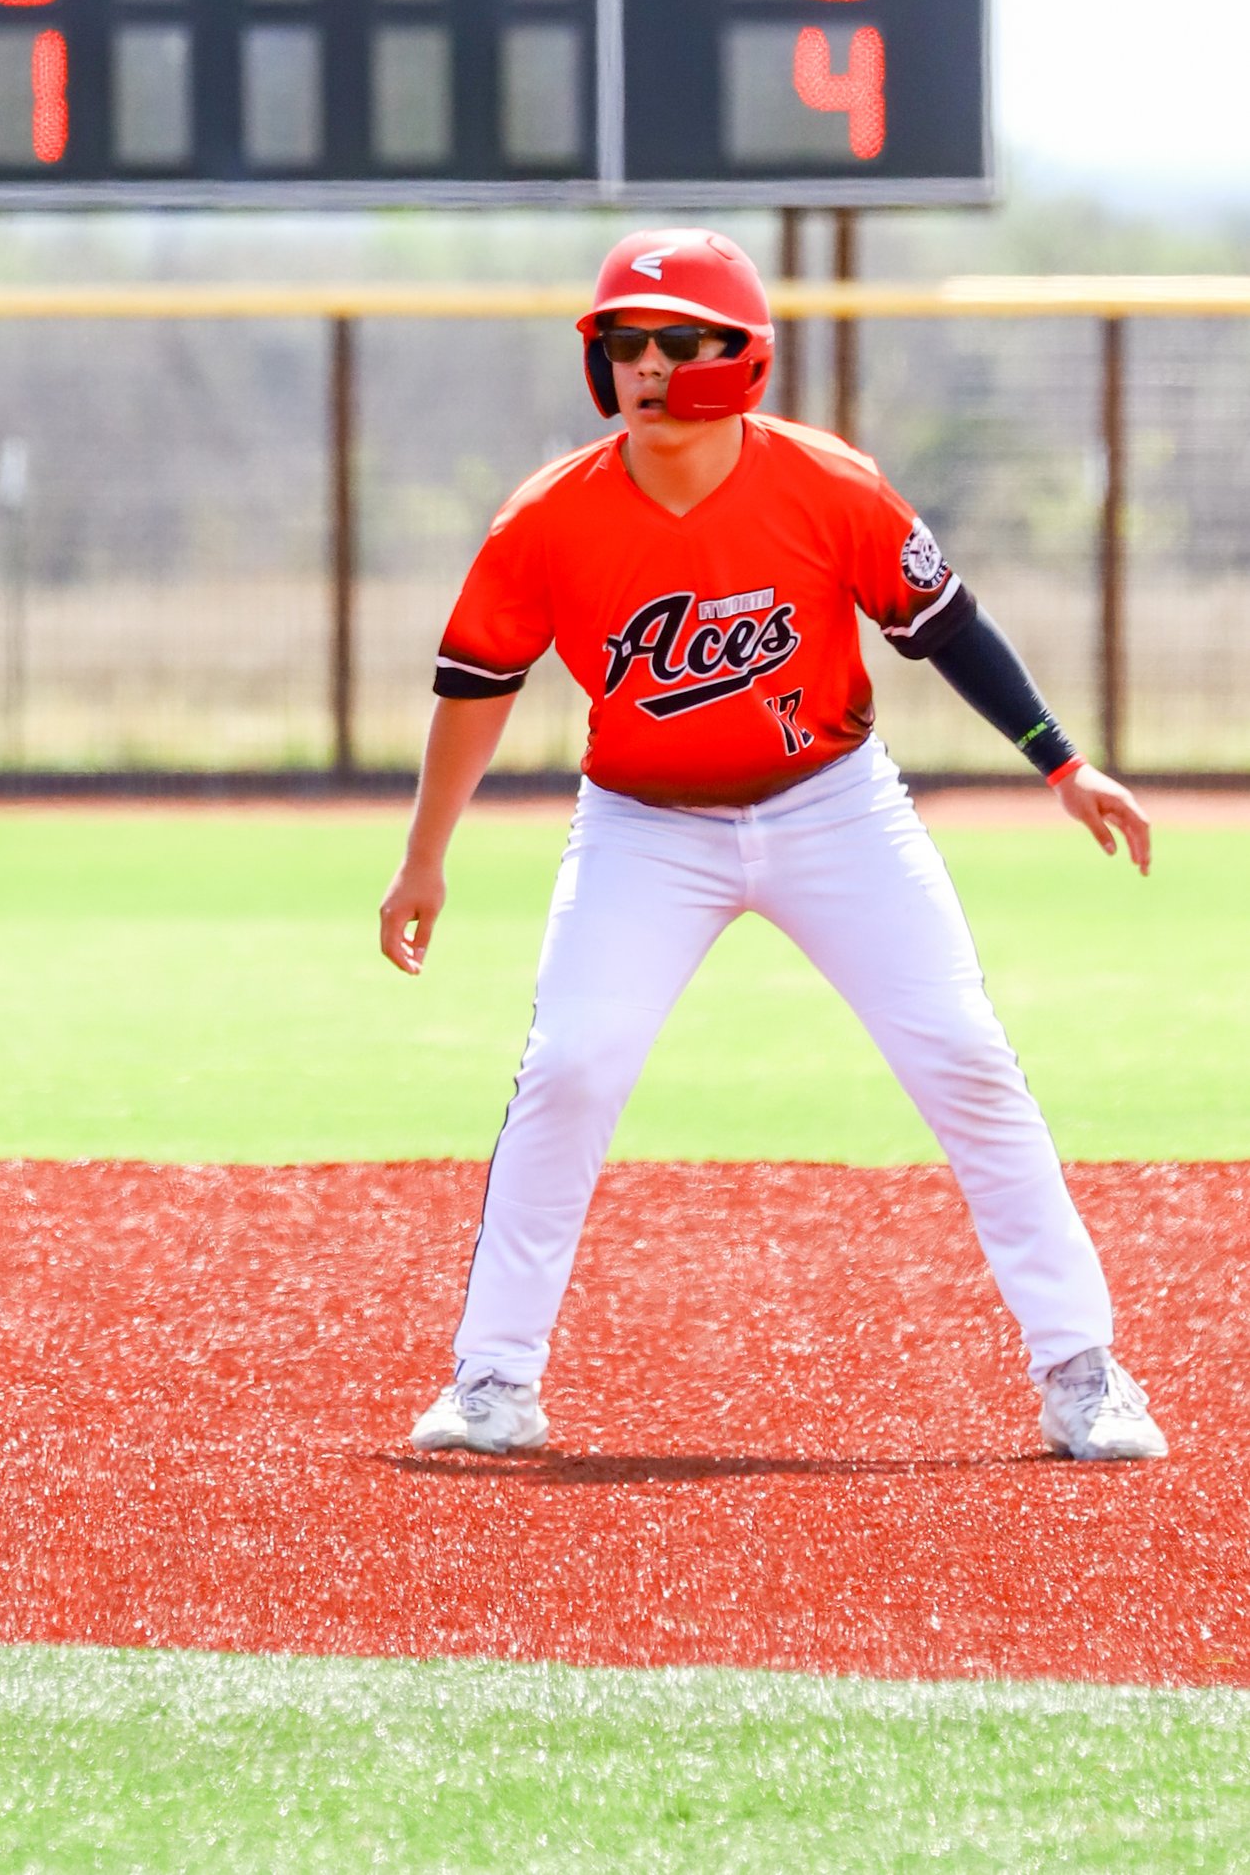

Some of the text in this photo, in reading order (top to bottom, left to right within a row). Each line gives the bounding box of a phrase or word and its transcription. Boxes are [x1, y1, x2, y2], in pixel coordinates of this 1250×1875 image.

[31, 29, 68, 163] 1
[793, 26, 886, 160] 4
[603, 591, 797, 698] Aces
[764, 687, 814, 756] 17
